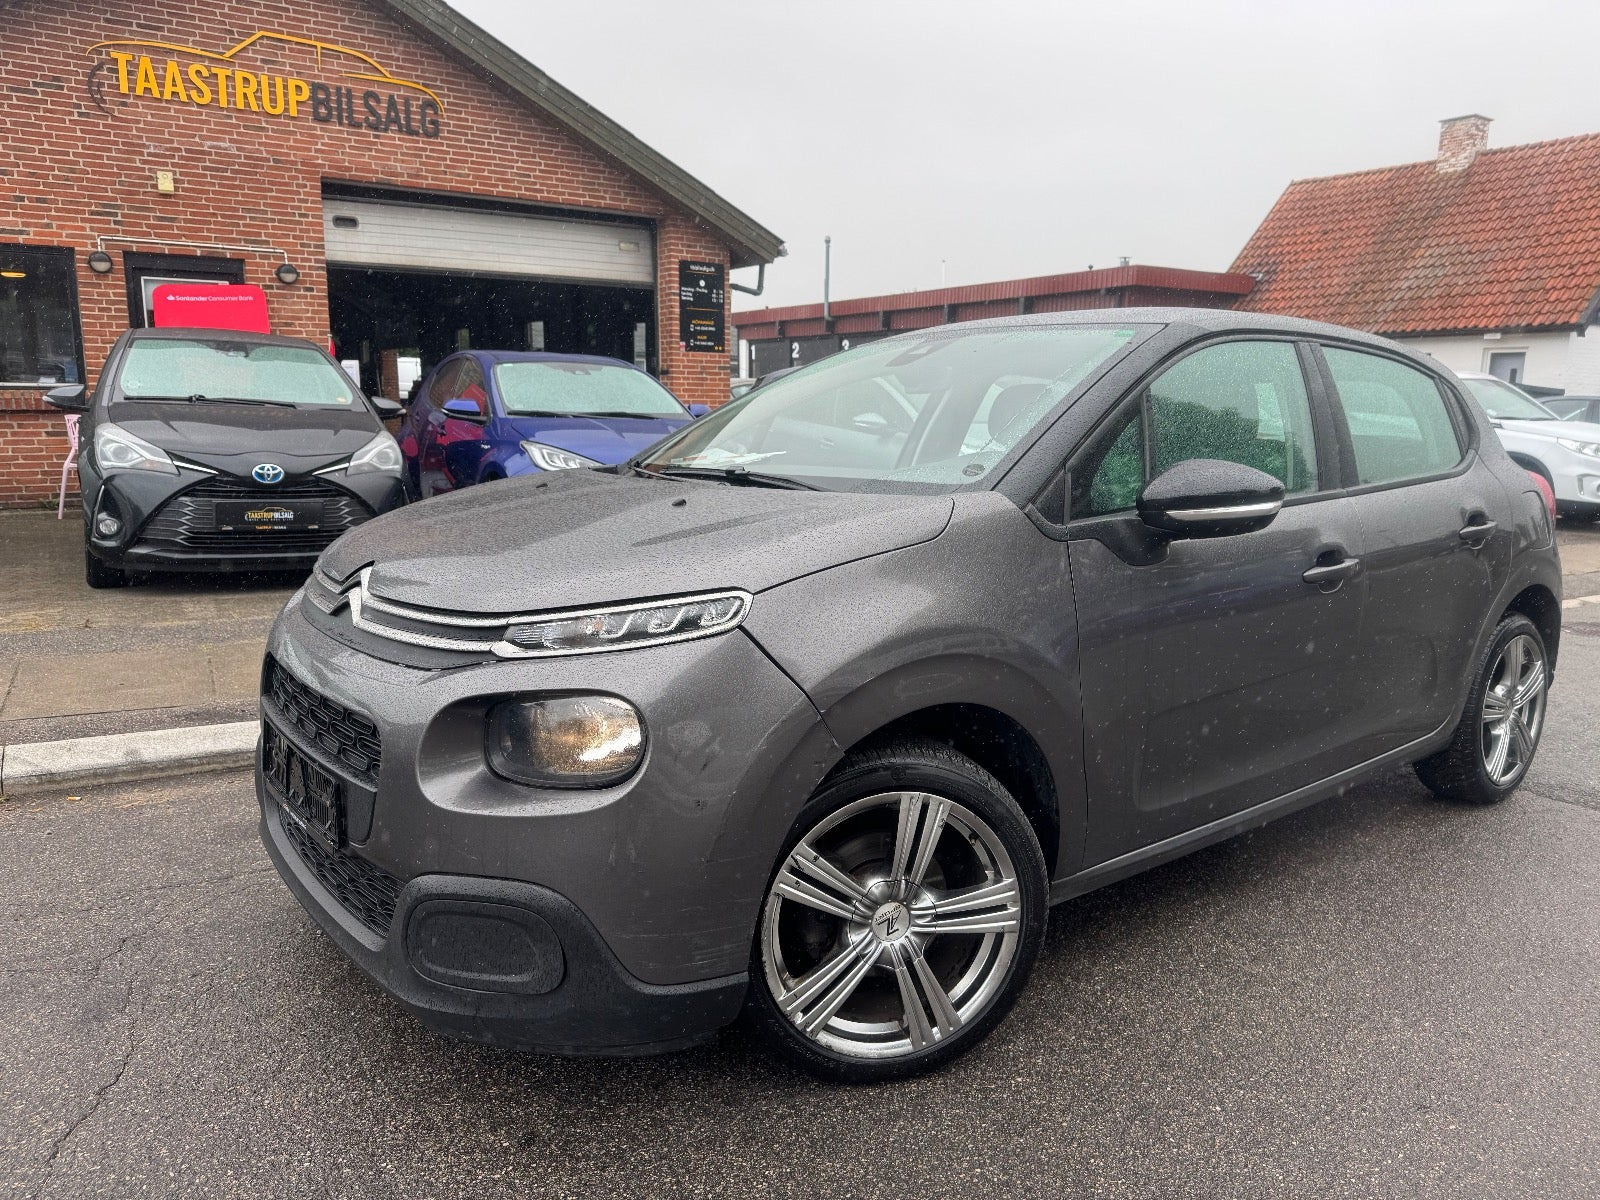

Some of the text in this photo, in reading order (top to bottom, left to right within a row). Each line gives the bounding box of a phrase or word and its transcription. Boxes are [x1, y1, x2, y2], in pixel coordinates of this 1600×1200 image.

[110, 51, 440, 138] TAASTRUPBILSALG
[750, 344, 756, 360] 1
[791, 341, 800, 359] 2
